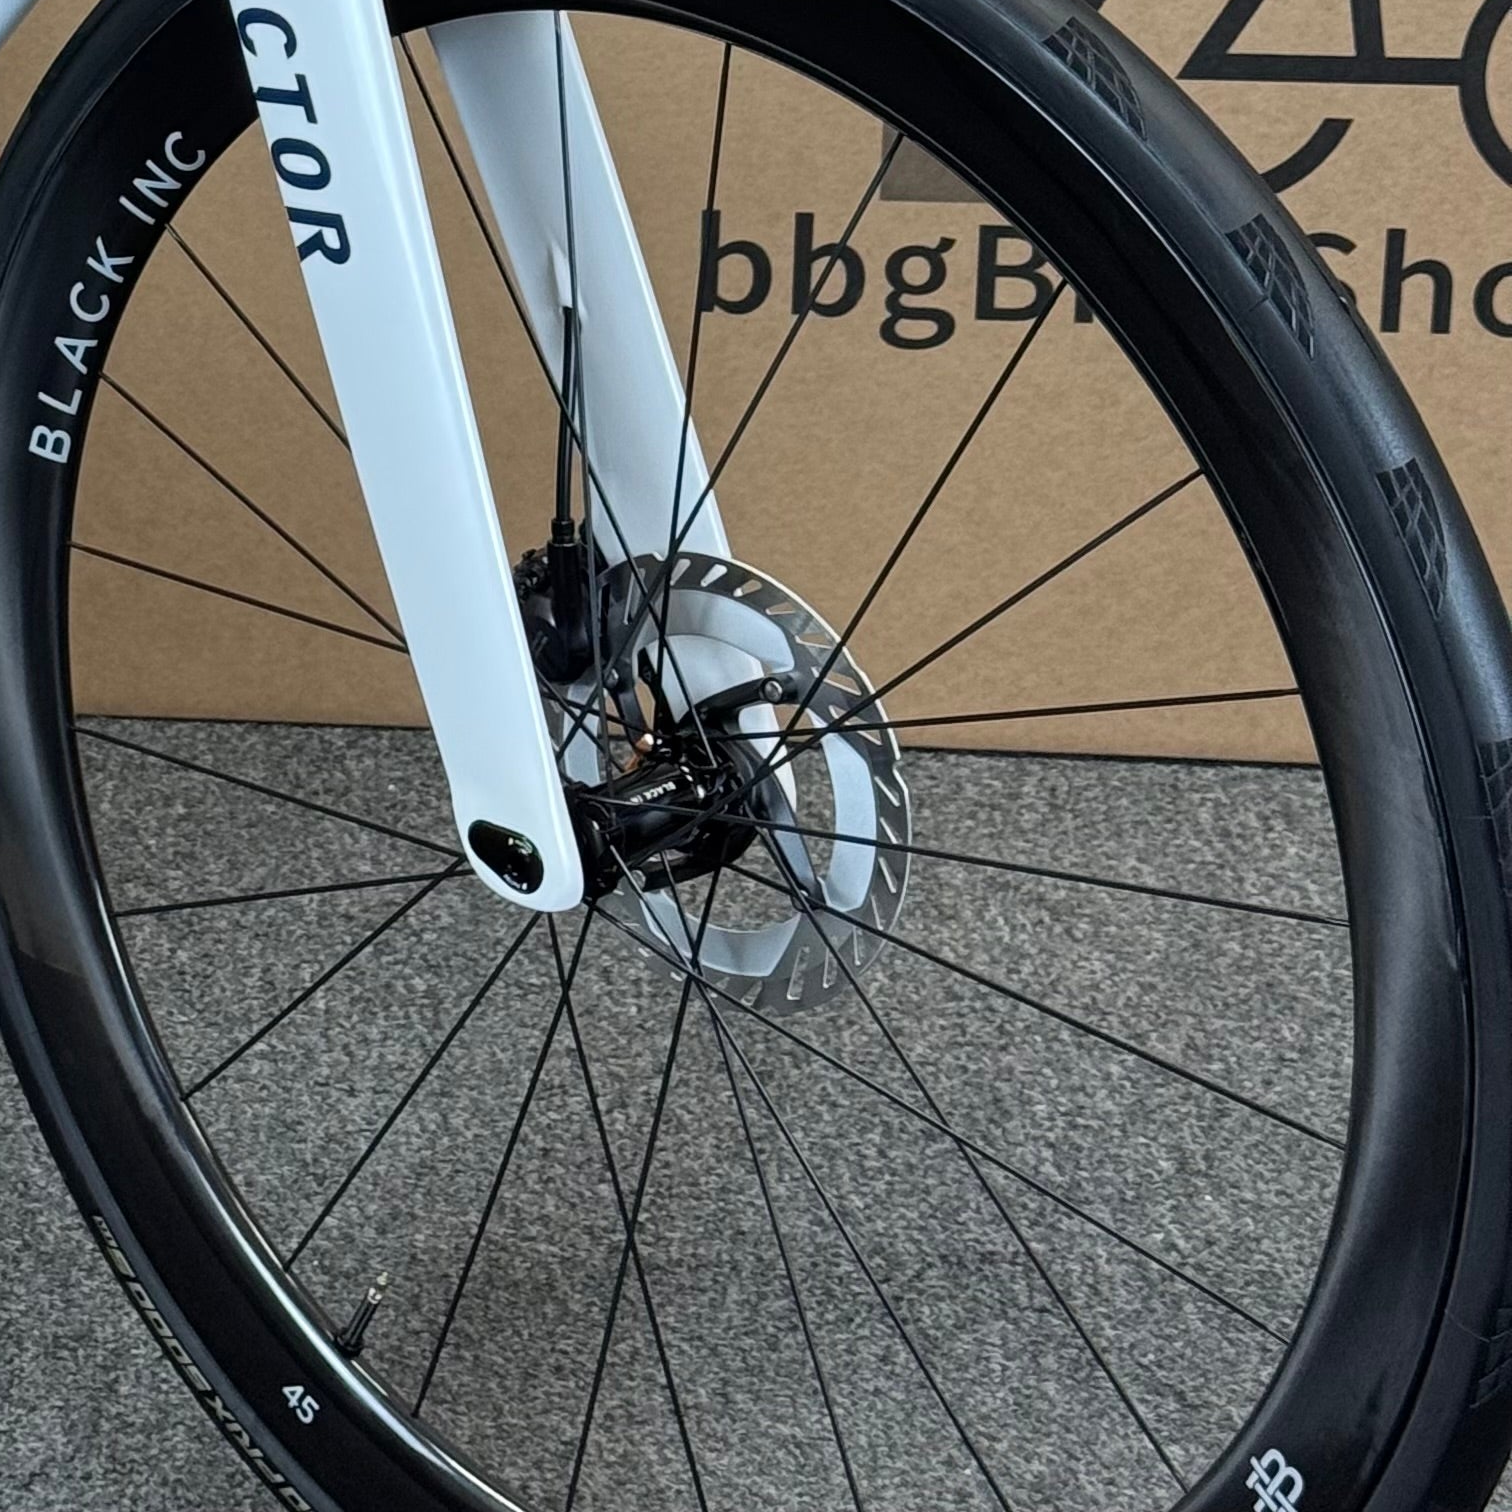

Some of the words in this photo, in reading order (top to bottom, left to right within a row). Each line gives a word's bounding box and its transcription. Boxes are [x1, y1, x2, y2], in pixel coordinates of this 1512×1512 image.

[28, 235, 136, 465] BLACK
[119, 130, 207, 226] INC
[207, 1394, 285, 1485] PRIX
[282, 1384, 320, 1425] 45
